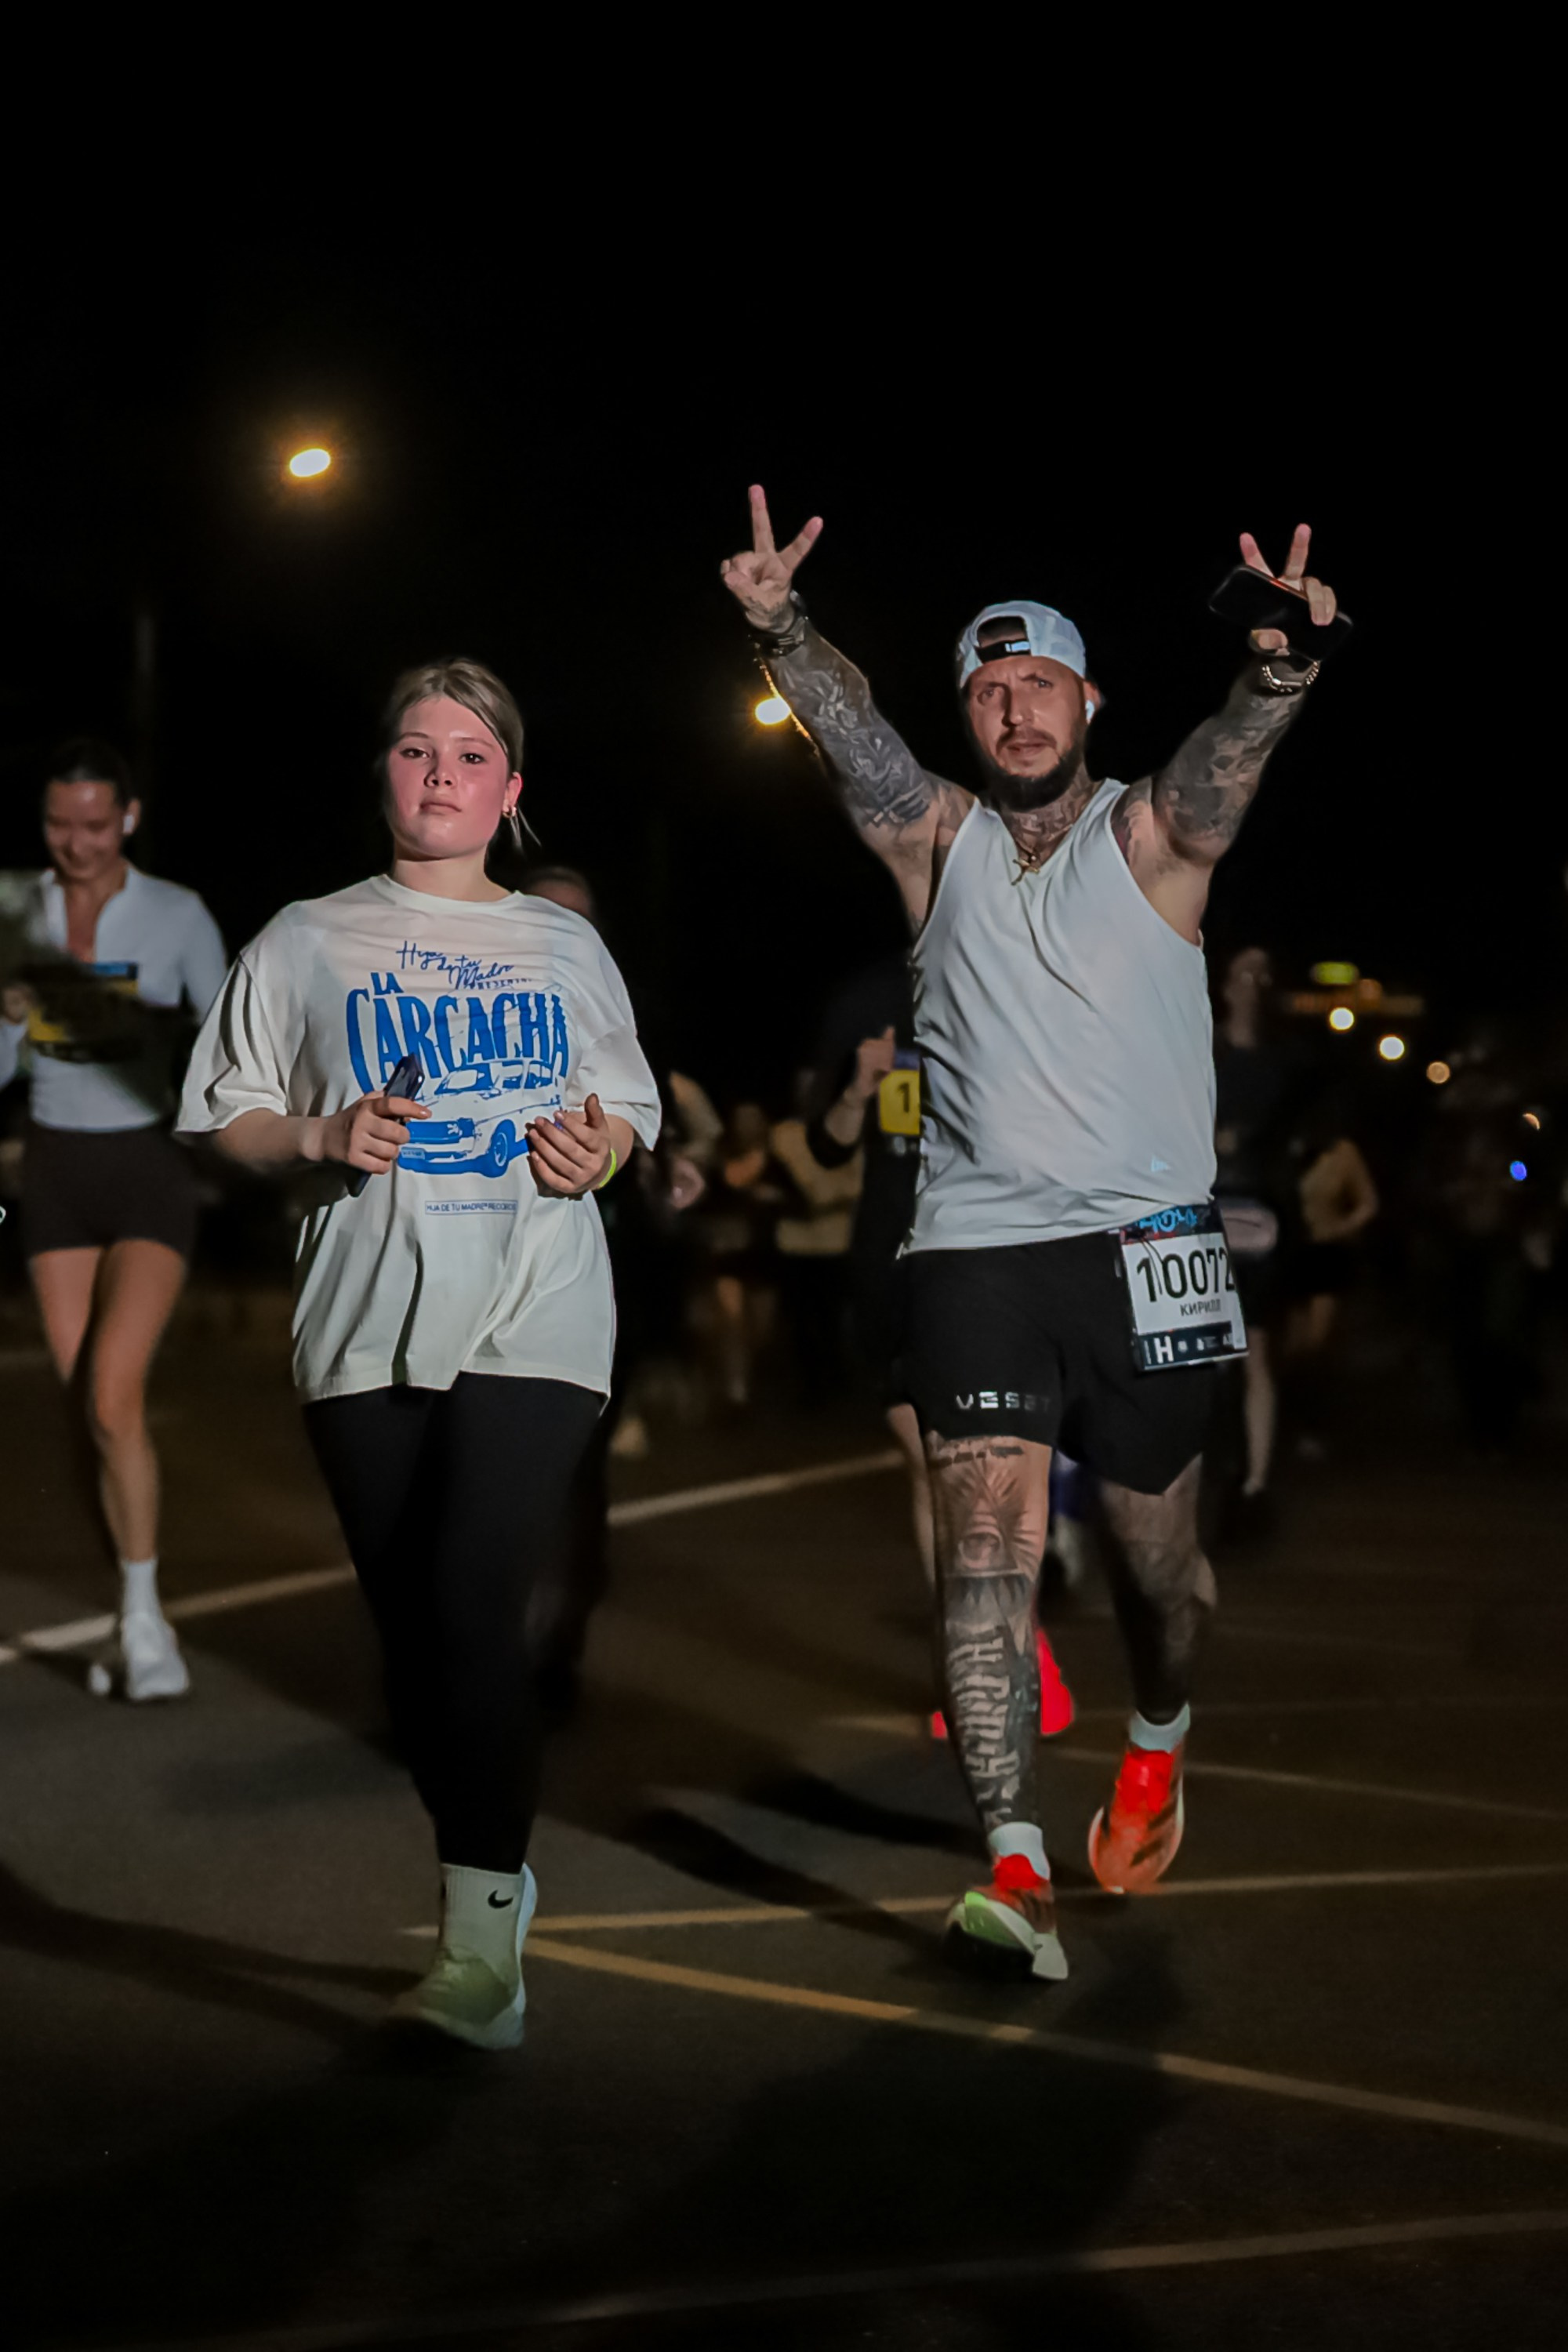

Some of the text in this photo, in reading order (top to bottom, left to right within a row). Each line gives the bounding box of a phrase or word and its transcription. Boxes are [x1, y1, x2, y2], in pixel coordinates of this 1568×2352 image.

[370, 971, 405, 995] LA
[346, 988, 569, 1095] CARCACHA
[441, 1203, 450, 1212] DE
